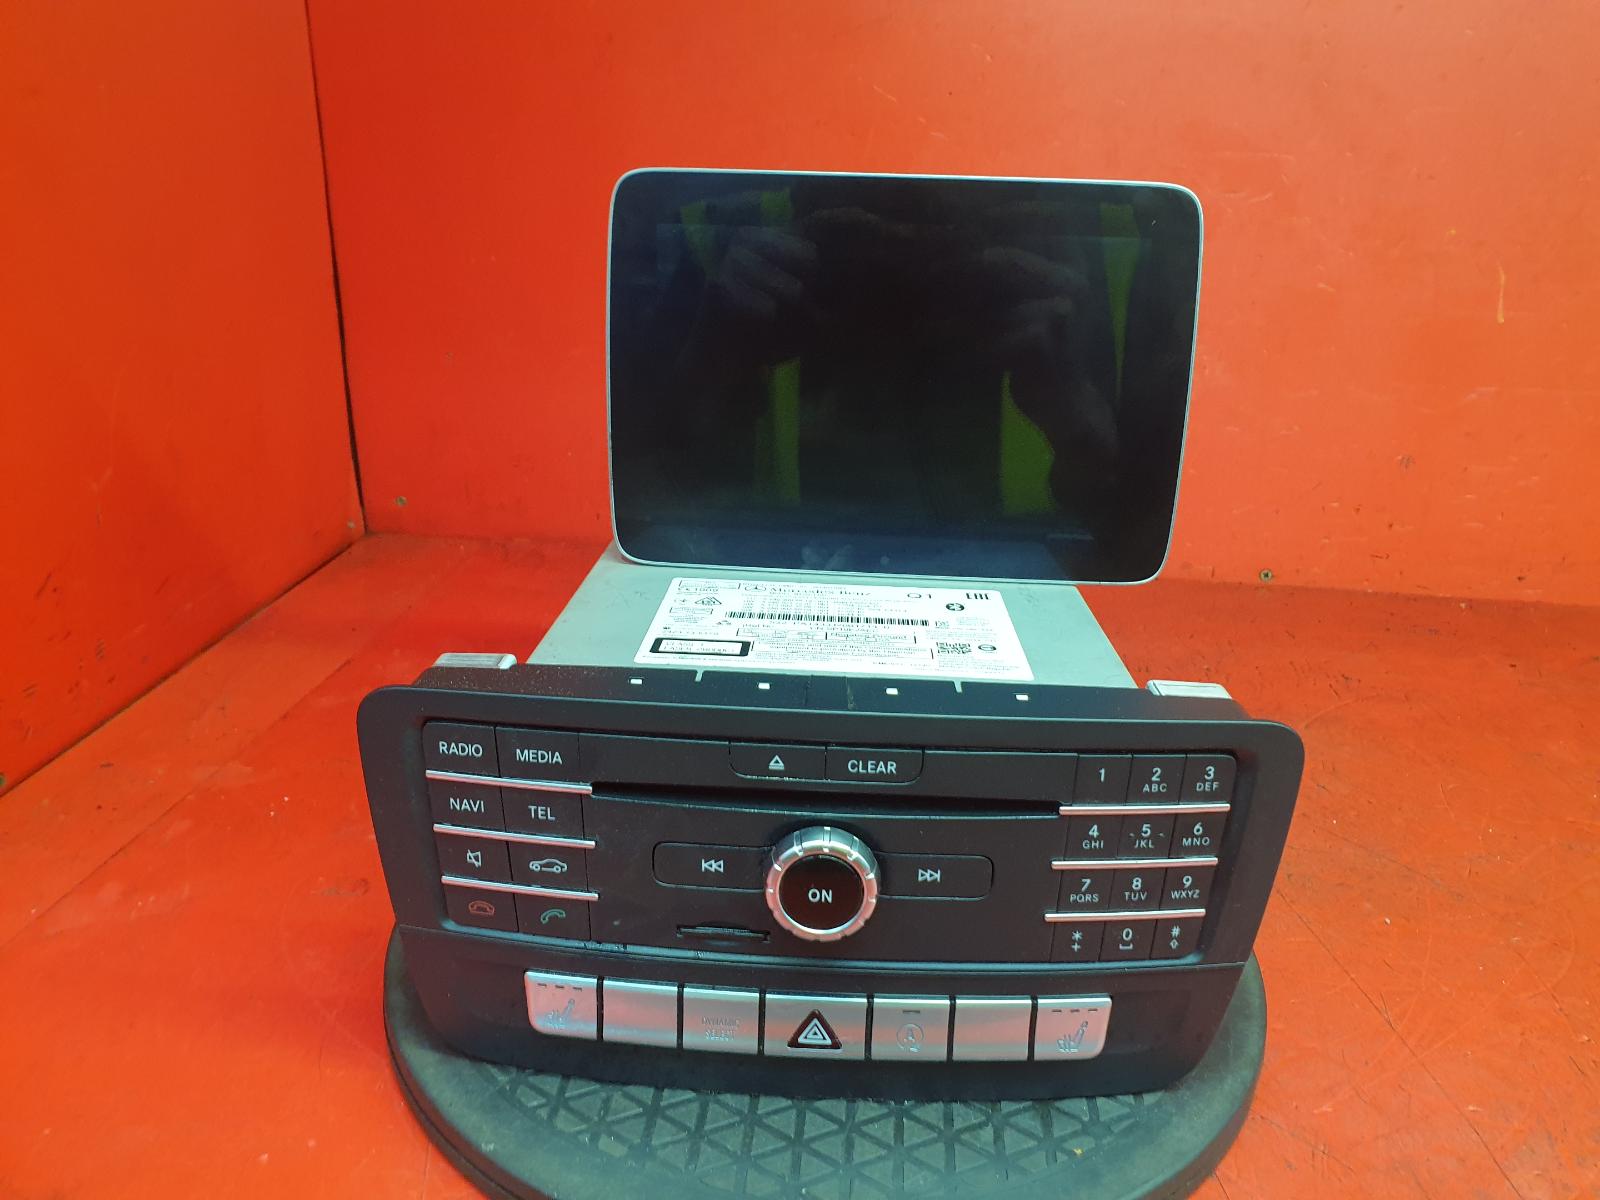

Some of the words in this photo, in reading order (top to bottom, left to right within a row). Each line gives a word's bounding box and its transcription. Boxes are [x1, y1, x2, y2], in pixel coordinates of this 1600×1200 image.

[438, 740, 483, 758] RADIO
[515, 748, 563, 765] MEDIA
[847, 759, 897, 774] CLEAR
[1204, 765, 1215, 781] 3
[1099, 767, 1105, 782] 1
[1151, 767, 1162, 782] 2
[1142, 783, 1168, 793] ABC
[1195, 781, 1219, 792] DEF
[449, 797, 485, 813] NAVI
[527, 805, 556, 821] TEL
[1088, 824, 1100, 839] 4
[1140, 823, 1151, 838] 5
[1193, 822, 1203, 836] 6
[1082, 839, 1104, 850] GHI
[1134, 839, 1154, 849] JKL
[1182, 836, 1210, 847] MNO
[1081, 878, 1092, 892] 7
[1131, 877, 1142, 891] 8
[1182, 875, 1193, 889] 9
[808, 888, 833, 904] ON
[1069, 893, 1099, 903] PQRS
[1124, 891, 1148, 902] TUV
[1170, 889, 1200, 900] WXYZ
[1122, 927, 1133, 941] 0
